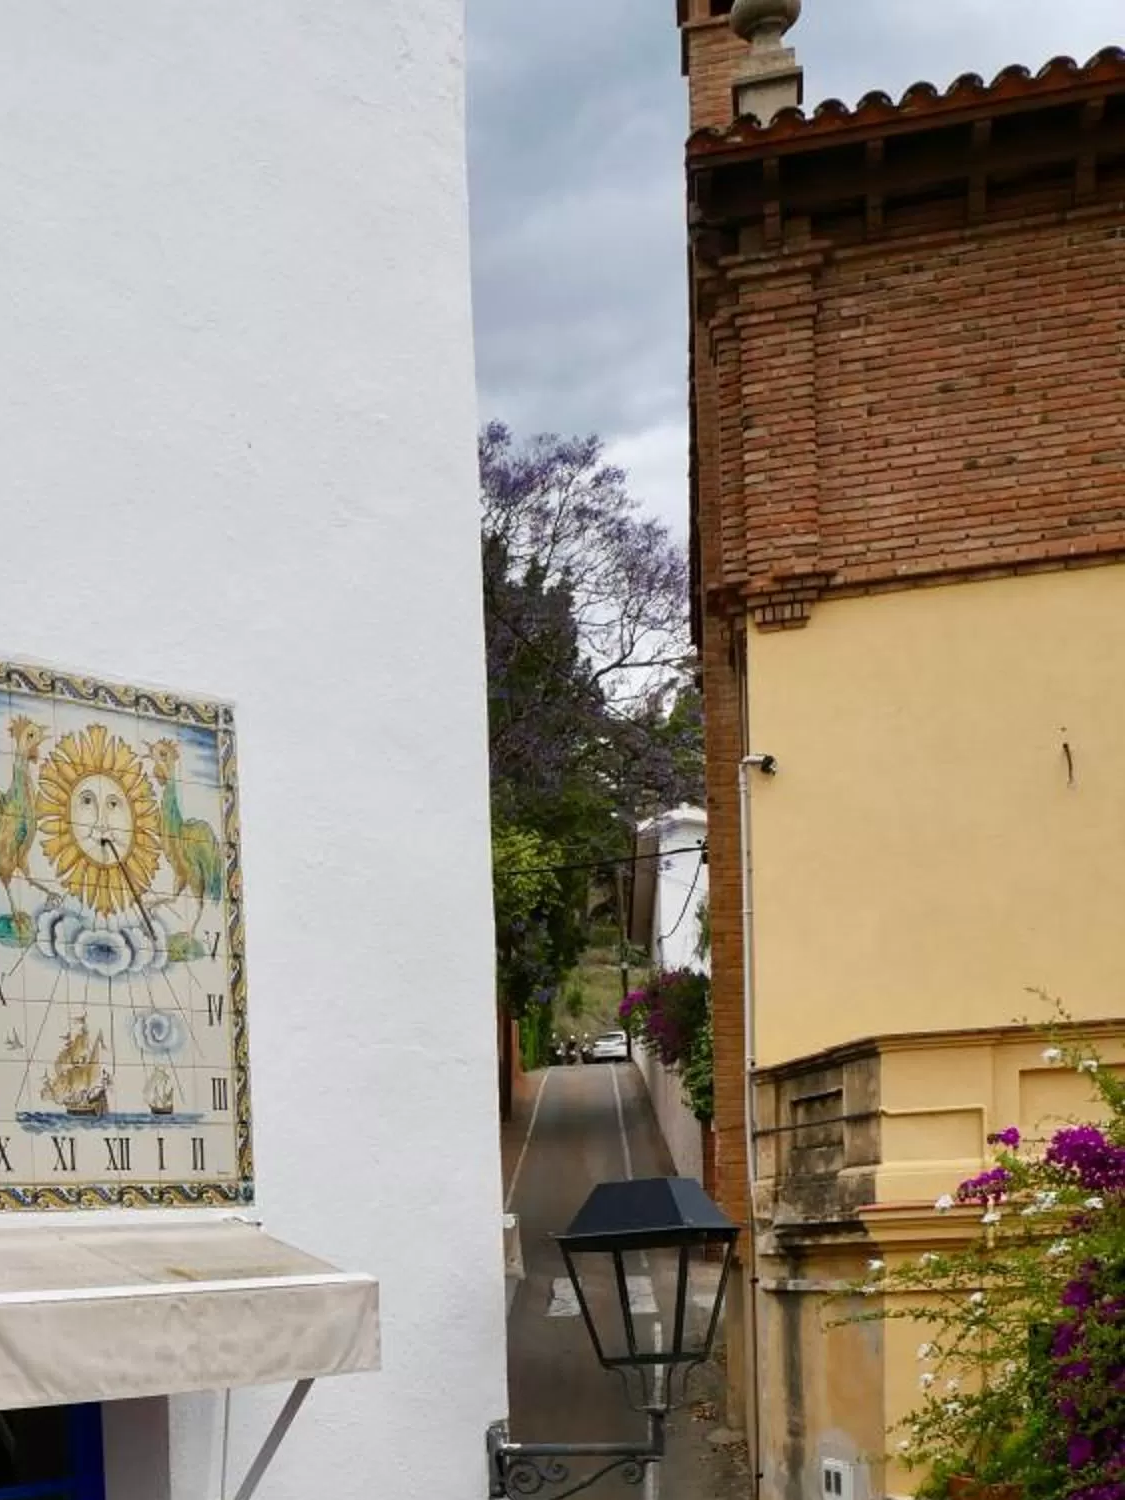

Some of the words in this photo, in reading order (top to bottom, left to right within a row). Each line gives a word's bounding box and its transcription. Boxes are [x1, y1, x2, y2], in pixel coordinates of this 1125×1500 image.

[207, 993, 224, 1026] IV
[211, 1077, 228, 1110] III
[51, 1135, 76, 1171] XI
[104, 1137, 132, 1171] XII
[157, 1137, 166, 1171] I
[191, 1137, 205, 1171] II
